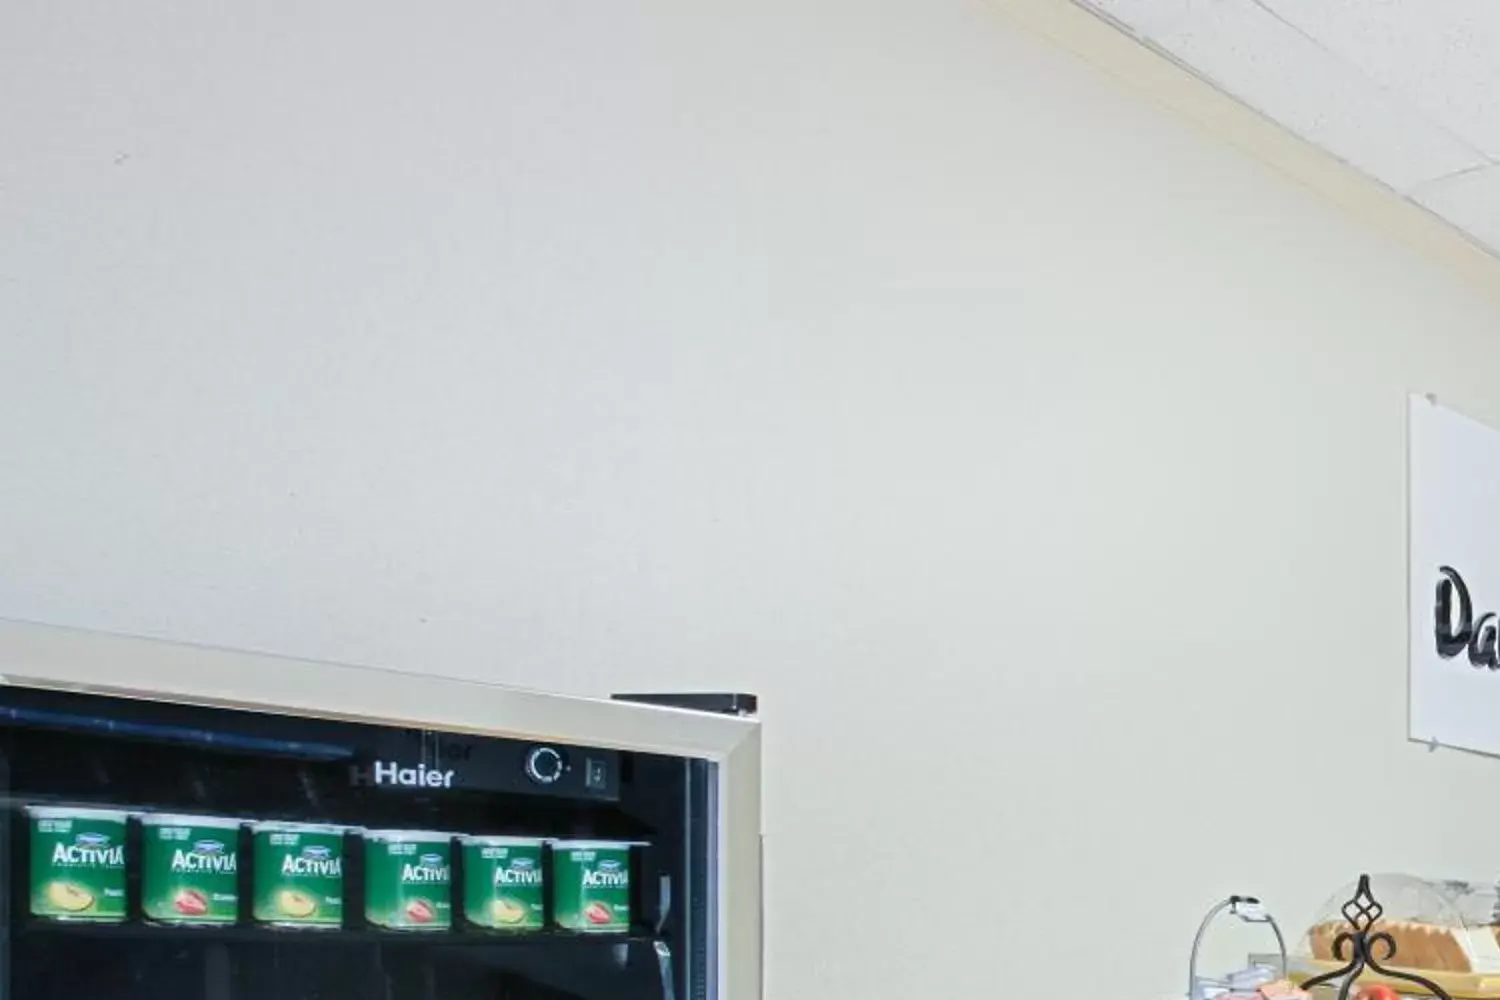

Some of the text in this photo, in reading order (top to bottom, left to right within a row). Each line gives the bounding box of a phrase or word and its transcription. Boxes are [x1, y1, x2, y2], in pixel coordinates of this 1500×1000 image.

[374, 759, 455, 789] Haier
[52, 842, 125, 866] ACTIVIA
[172, 848, 237, 871] ACTIVIA
[282, 853, 341, 876] ACTIVIA
